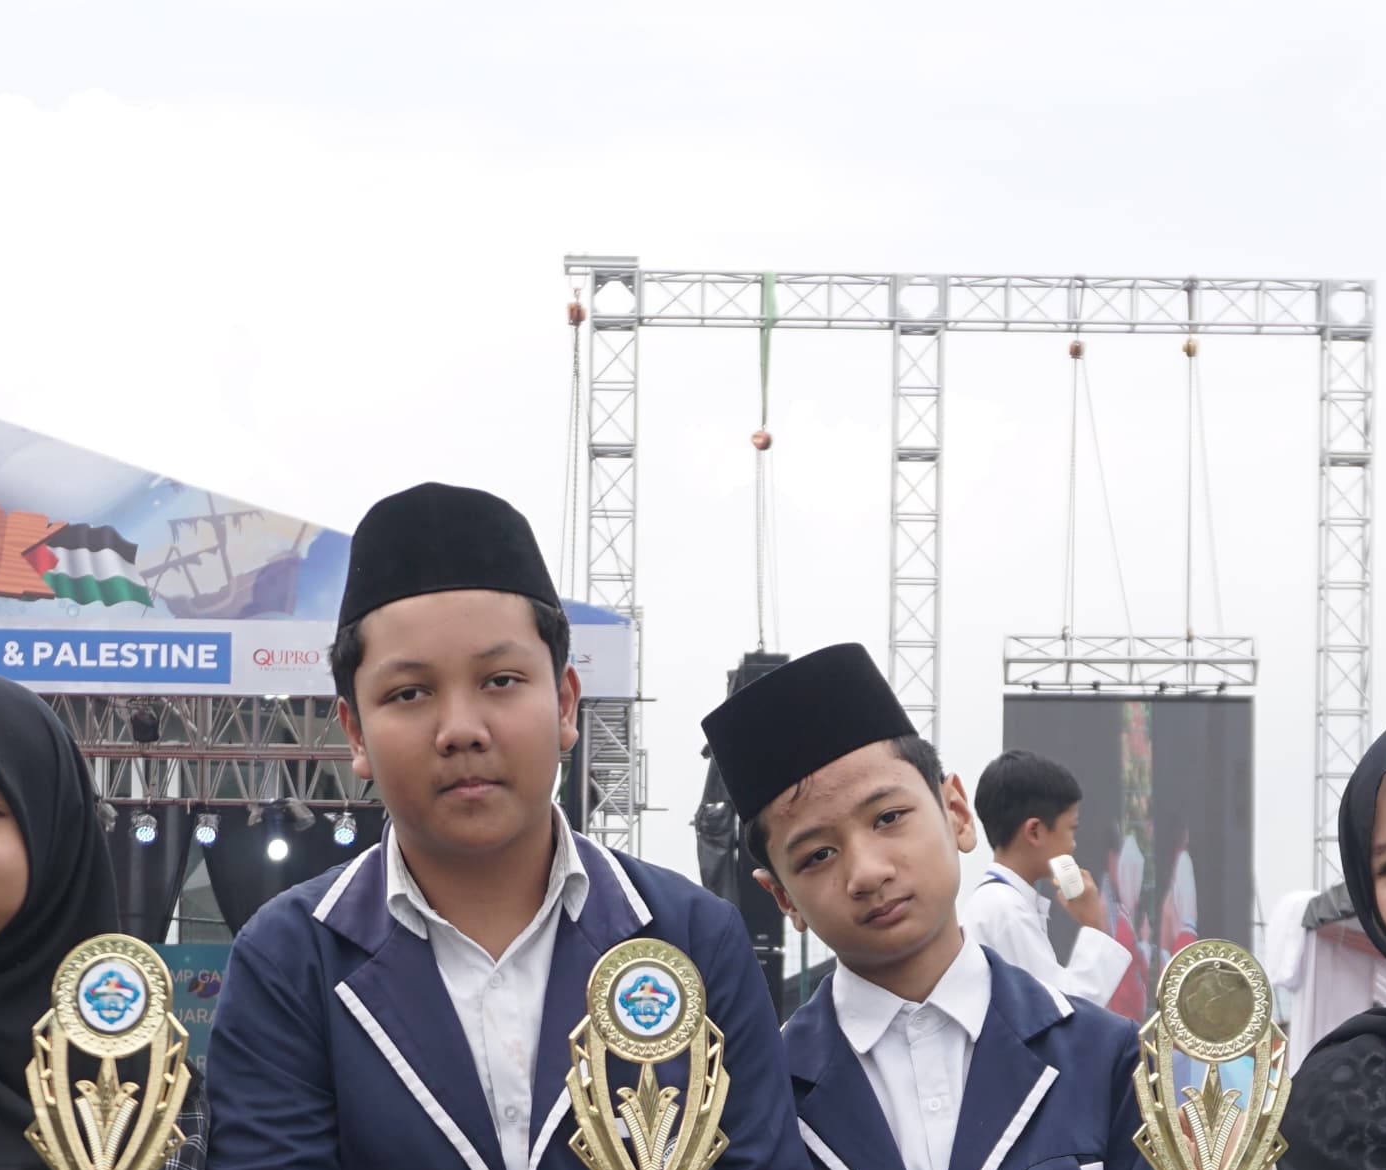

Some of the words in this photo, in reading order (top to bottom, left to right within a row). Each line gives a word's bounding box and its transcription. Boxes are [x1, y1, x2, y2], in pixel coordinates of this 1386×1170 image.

[2, 641, 24, 667] &
[32, 641, 218, 669] PALESTINE
[253, 648, 320, 666] QUPRO
